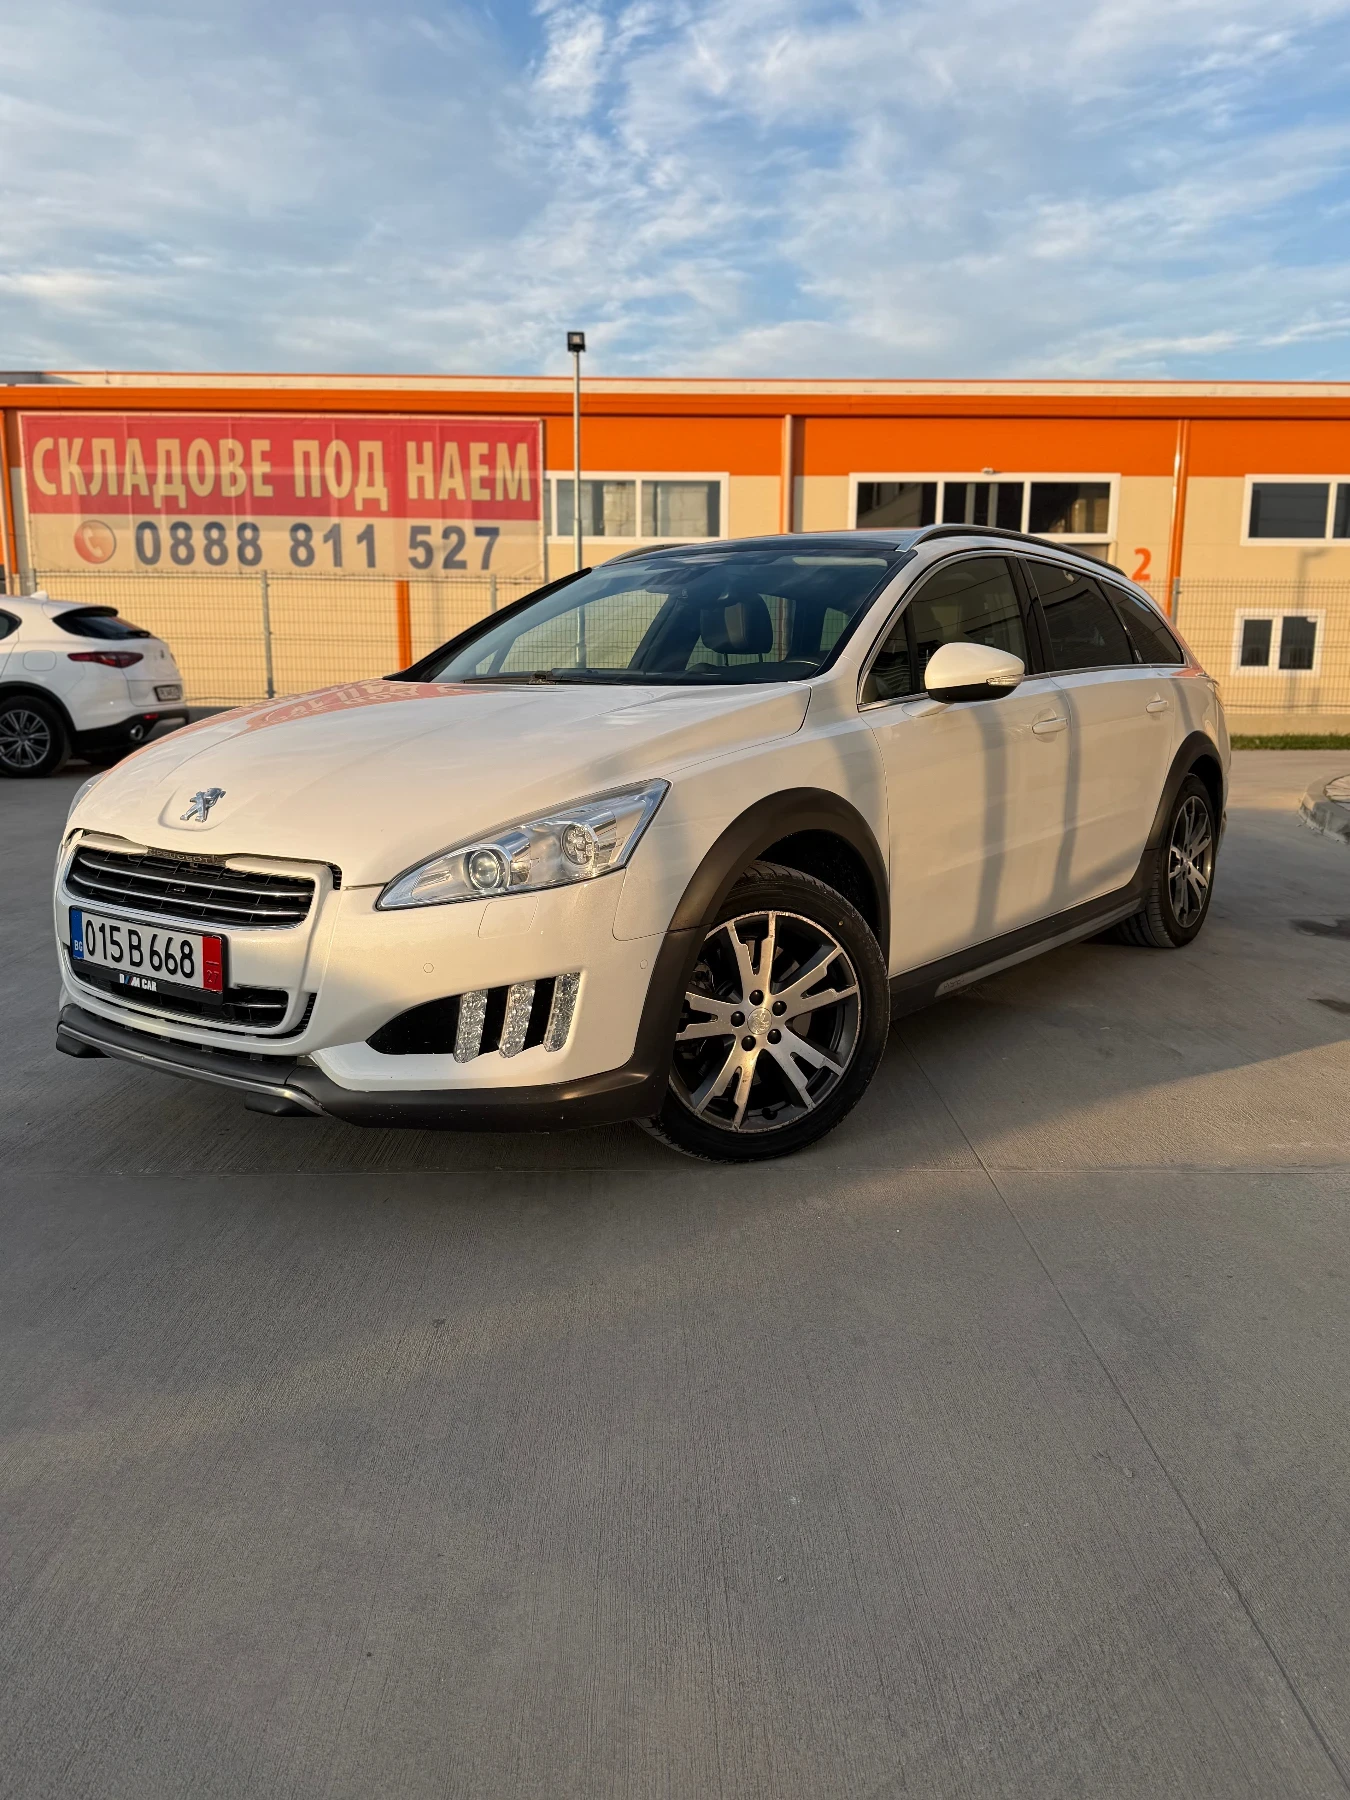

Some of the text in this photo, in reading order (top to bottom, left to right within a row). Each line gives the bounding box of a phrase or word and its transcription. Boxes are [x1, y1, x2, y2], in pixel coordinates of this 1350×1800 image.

[32, 437, 531, 511] СКЛАДОВЕ ПОД НАЕМ
[135, 521, 500, 570] 0888 811 527
[1132, 547, 1152, 581] 2
[74, 939, 84, 952] BG
[141, 978, 157, 992] CAR
